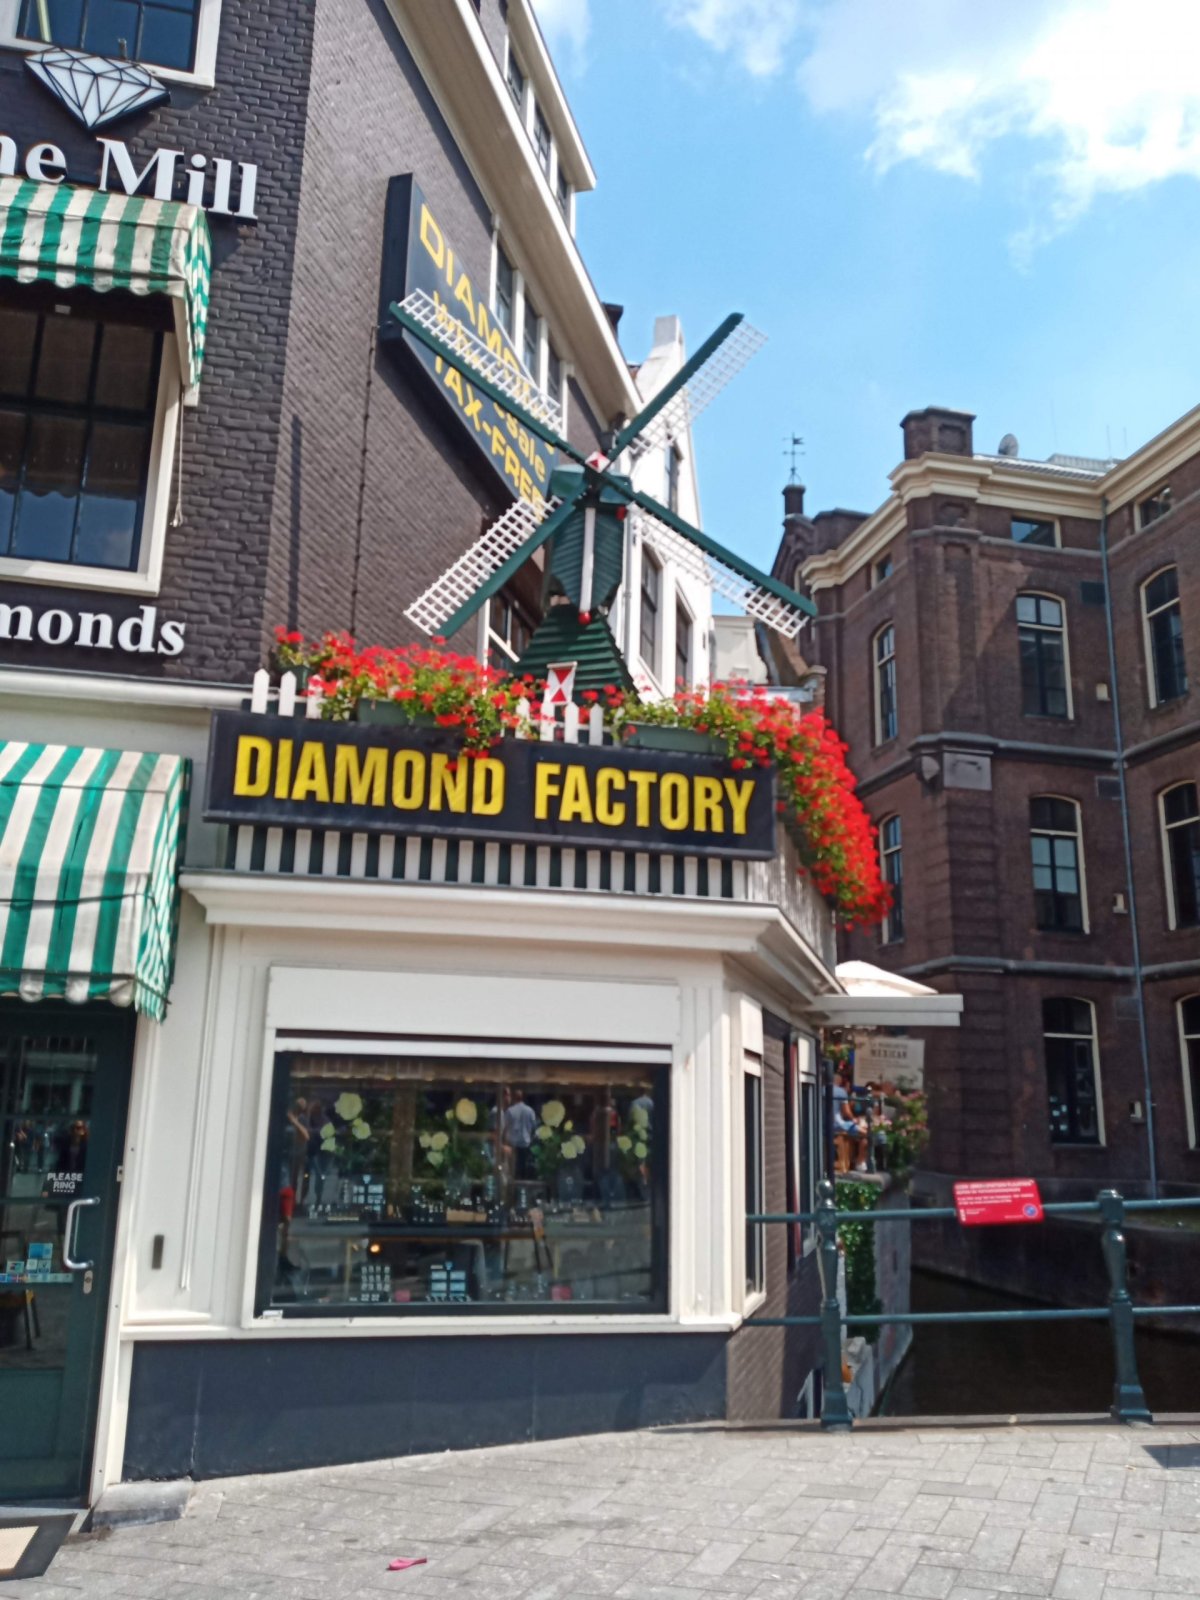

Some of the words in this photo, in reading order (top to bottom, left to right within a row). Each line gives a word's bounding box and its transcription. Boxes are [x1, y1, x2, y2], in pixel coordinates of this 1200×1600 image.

[96, 137, 258, 219] Mill
[233, 734, 505, 816] DIAMOND
[534, 762, 755, 834] FACTORY
[47, 1172, 83, 1182] PLEASE
[53, 1181, 76, 1190] RING
